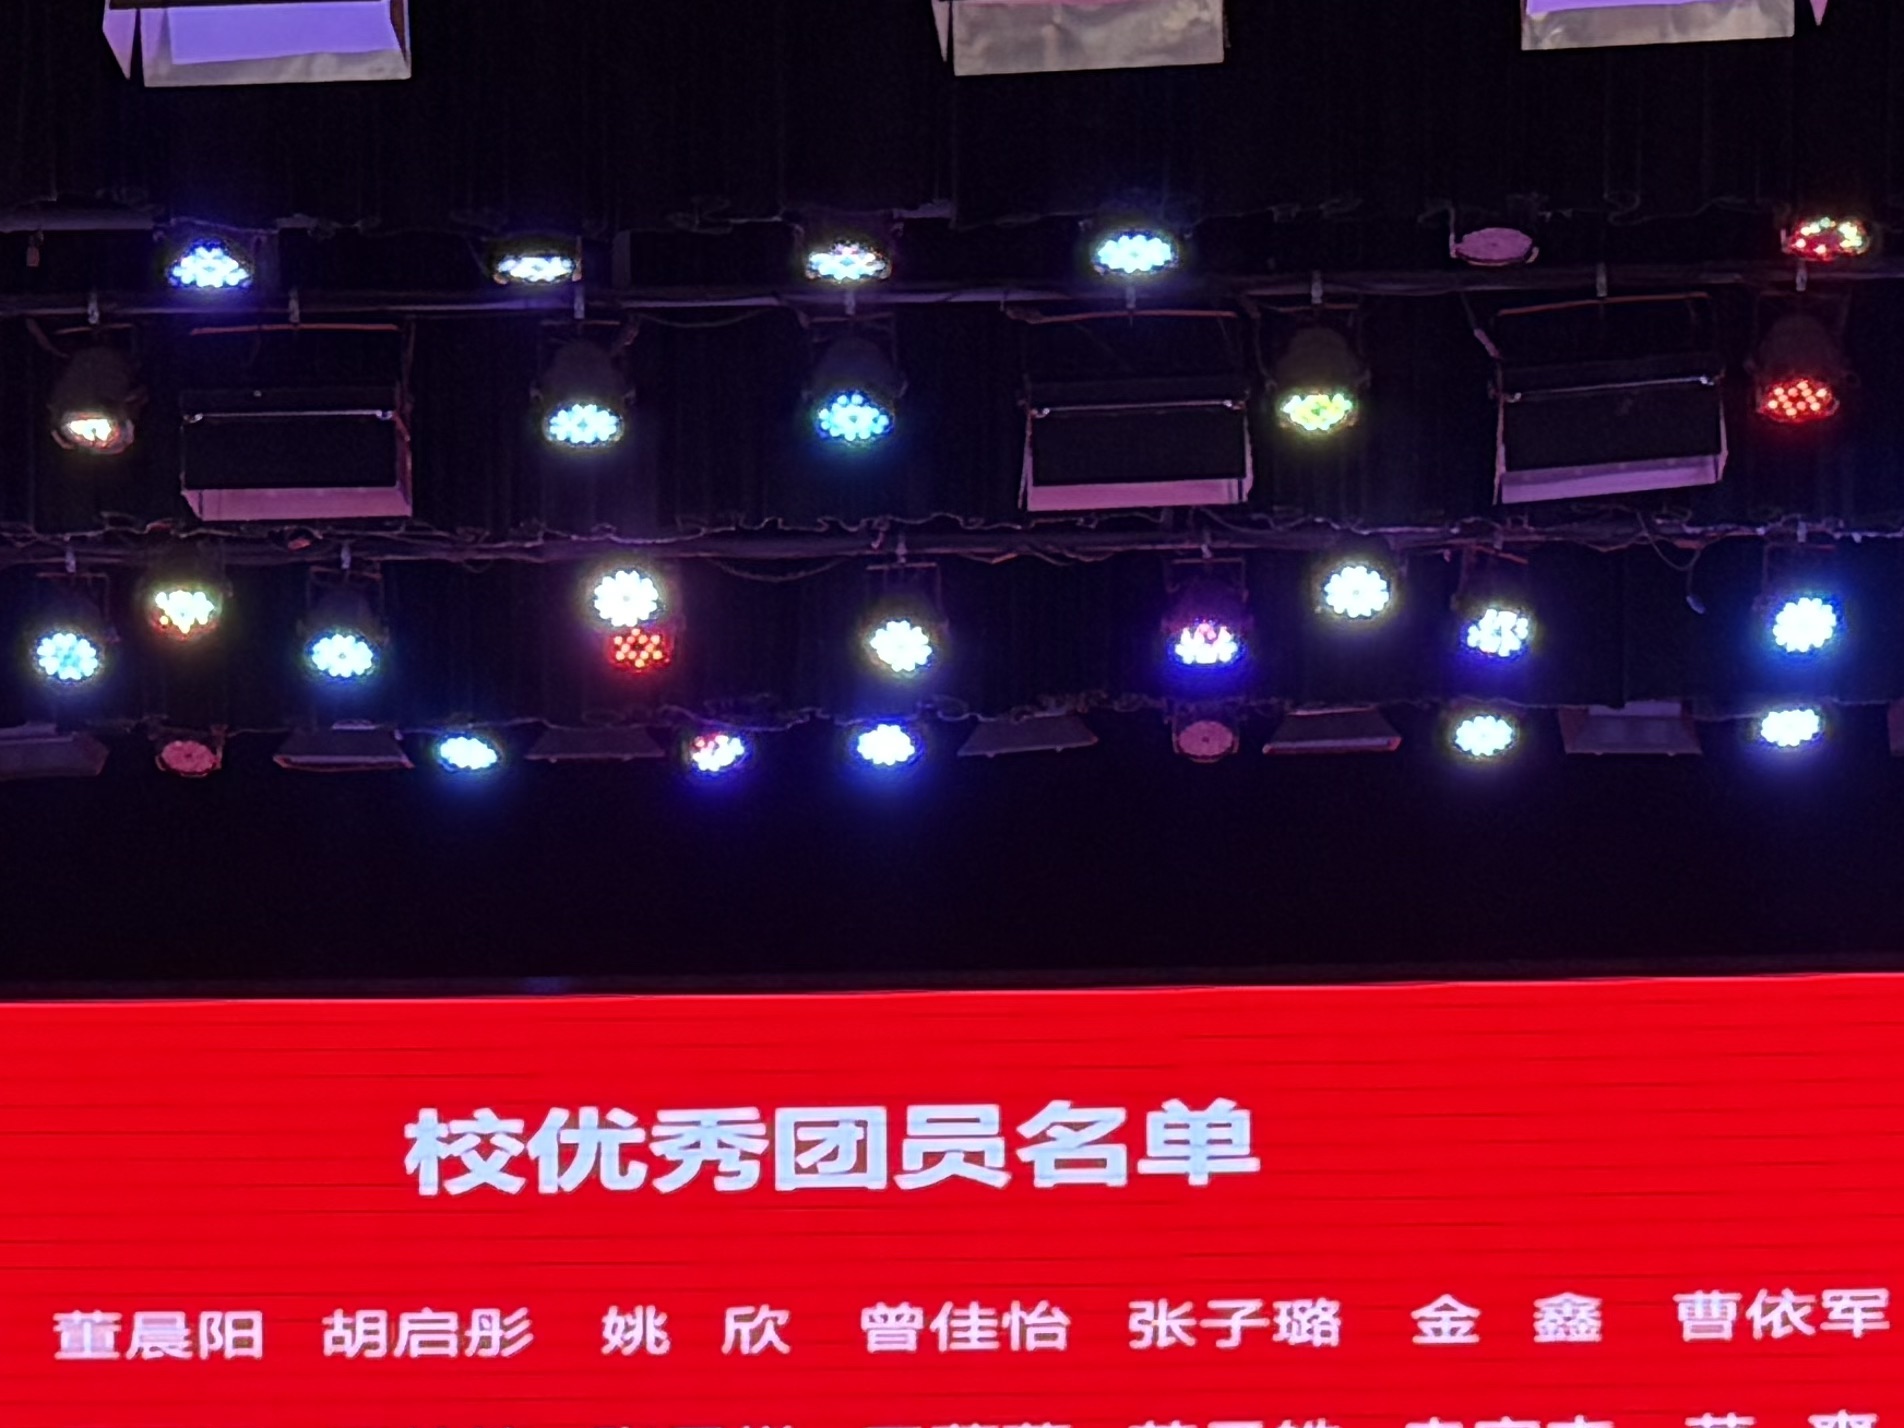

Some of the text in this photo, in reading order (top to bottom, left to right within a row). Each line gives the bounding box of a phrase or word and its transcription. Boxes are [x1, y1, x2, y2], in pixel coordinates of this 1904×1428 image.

[405, 1098, 1260, 1195] 校优秀团员名单
[55, 1311, 262, 1359] 董晨阳
[323, 1308, 532, 1357] 胡启彤
[861, 1301, 1070, 1352] 曾佳怡
[1129, 1298, 1341, 1348] 张子璐
[1674, 1289, 1888, 1341] 曹依军
